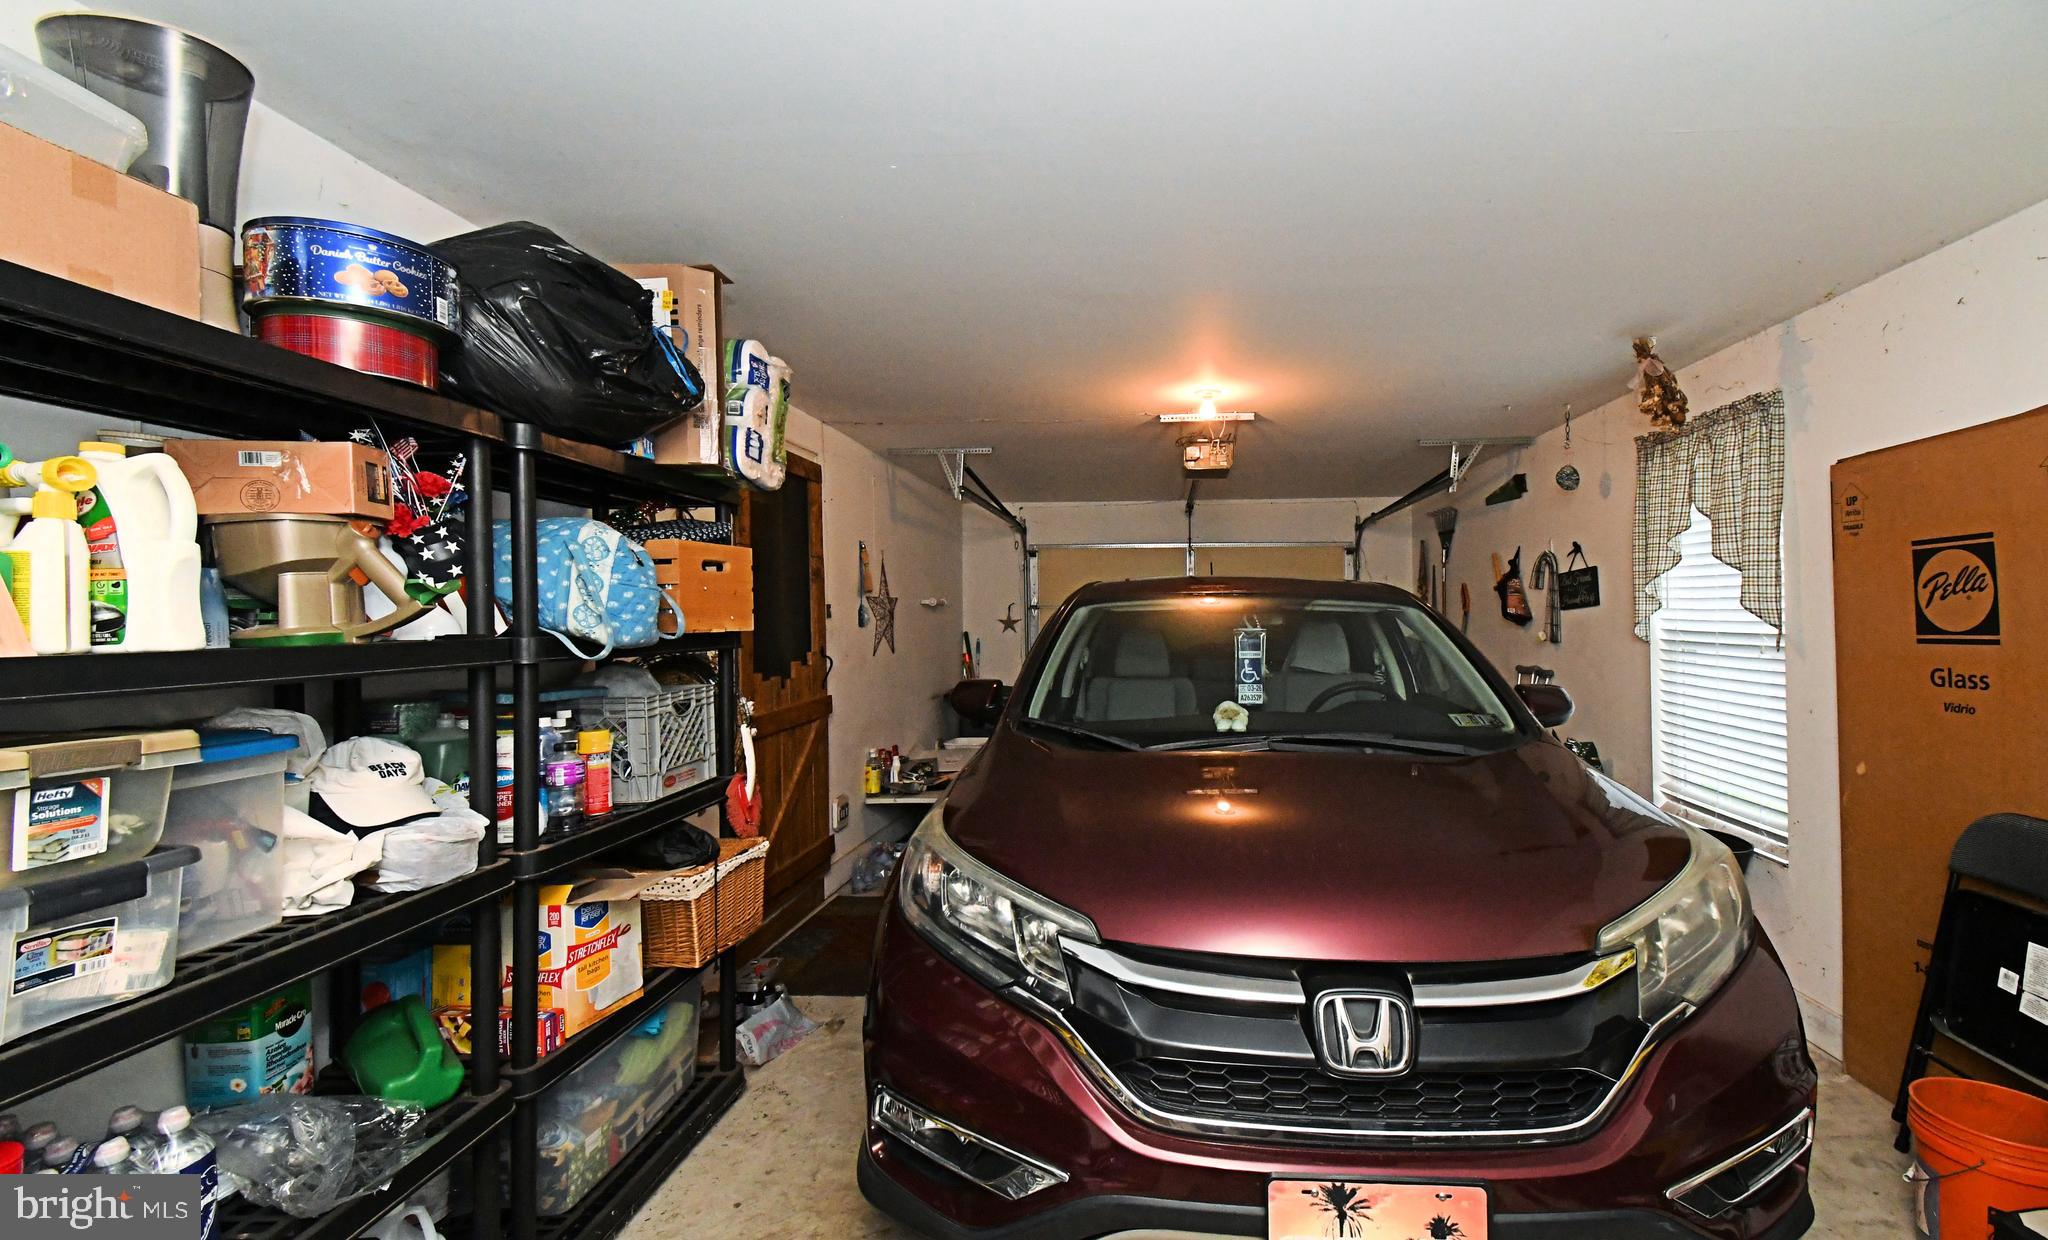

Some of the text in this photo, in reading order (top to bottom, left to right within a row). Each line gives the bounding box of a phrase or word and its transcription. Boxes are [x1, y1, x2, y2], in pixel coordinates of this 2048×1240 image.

[310, 244, 353, 260] Danish
[355, 251, 392, 268] Butter
[393, 261, 428, 279] Cookies
[1846, 496, 1858, 507] UP
[1922, 564, 1989, 610] Pella
[1930, 667, 1991, 691] Glass
[1943, 702, 1976, 715] Vidrio
[368, 762, 406, 772] BEACH
[378, 768, 408, 779] DAYS
[36, 789, 72, 801] Hefty
[31, 806, 82, 820] Solutions
[549, 911, 560, 921] 200
[568, 932, 617, 964] STRETCHFLEX
[577, 955, 609, 974] tall kitchen
[586, 965, 601, 976] bags
